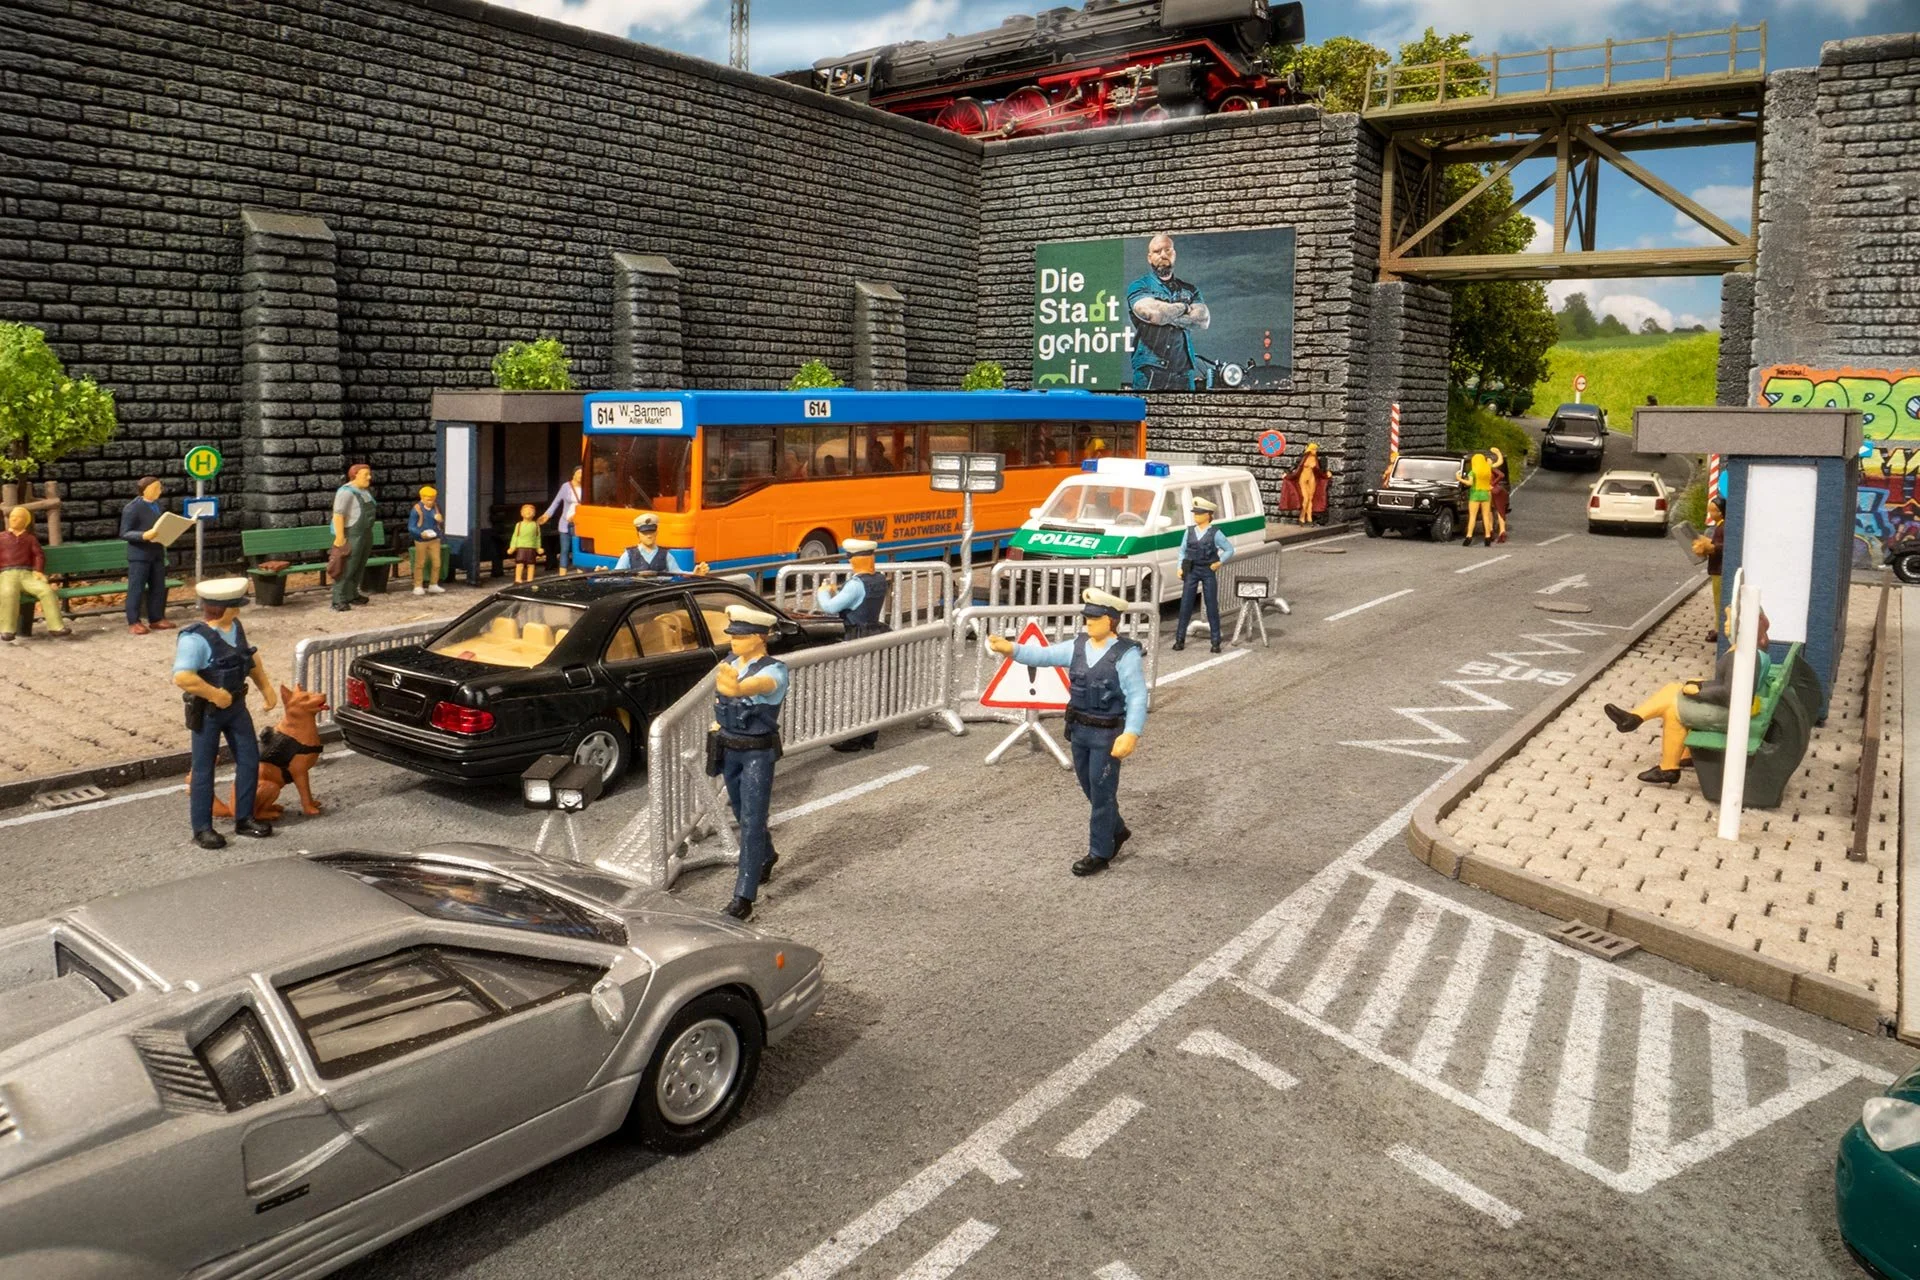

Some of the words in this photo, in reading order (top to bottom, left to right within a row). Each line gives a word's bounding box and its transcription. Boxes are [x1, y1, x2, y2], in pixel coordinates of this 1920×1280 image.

[1041, 267, 1085, 294] Die
[1039, 289, 1120, 324] Stadt
[1038, 326, 1135, 360] gehört
[597, 407, 614, 425] 614
[619, 404, 672, 417] W.-Barmen
[809, 401, 827, 416] 614
[645, 416, 662, 425] Markt
[196, 454, 211, 472] H
[894, 508, 958, 524] WUPPERTALER
[854, 519, 886, 535] WSW
[893, 523, 952, 538] STADTWERKE
[1027, 533, 1101, 550] POLIZEI
[1456, 660, 1577, 687] BUS
